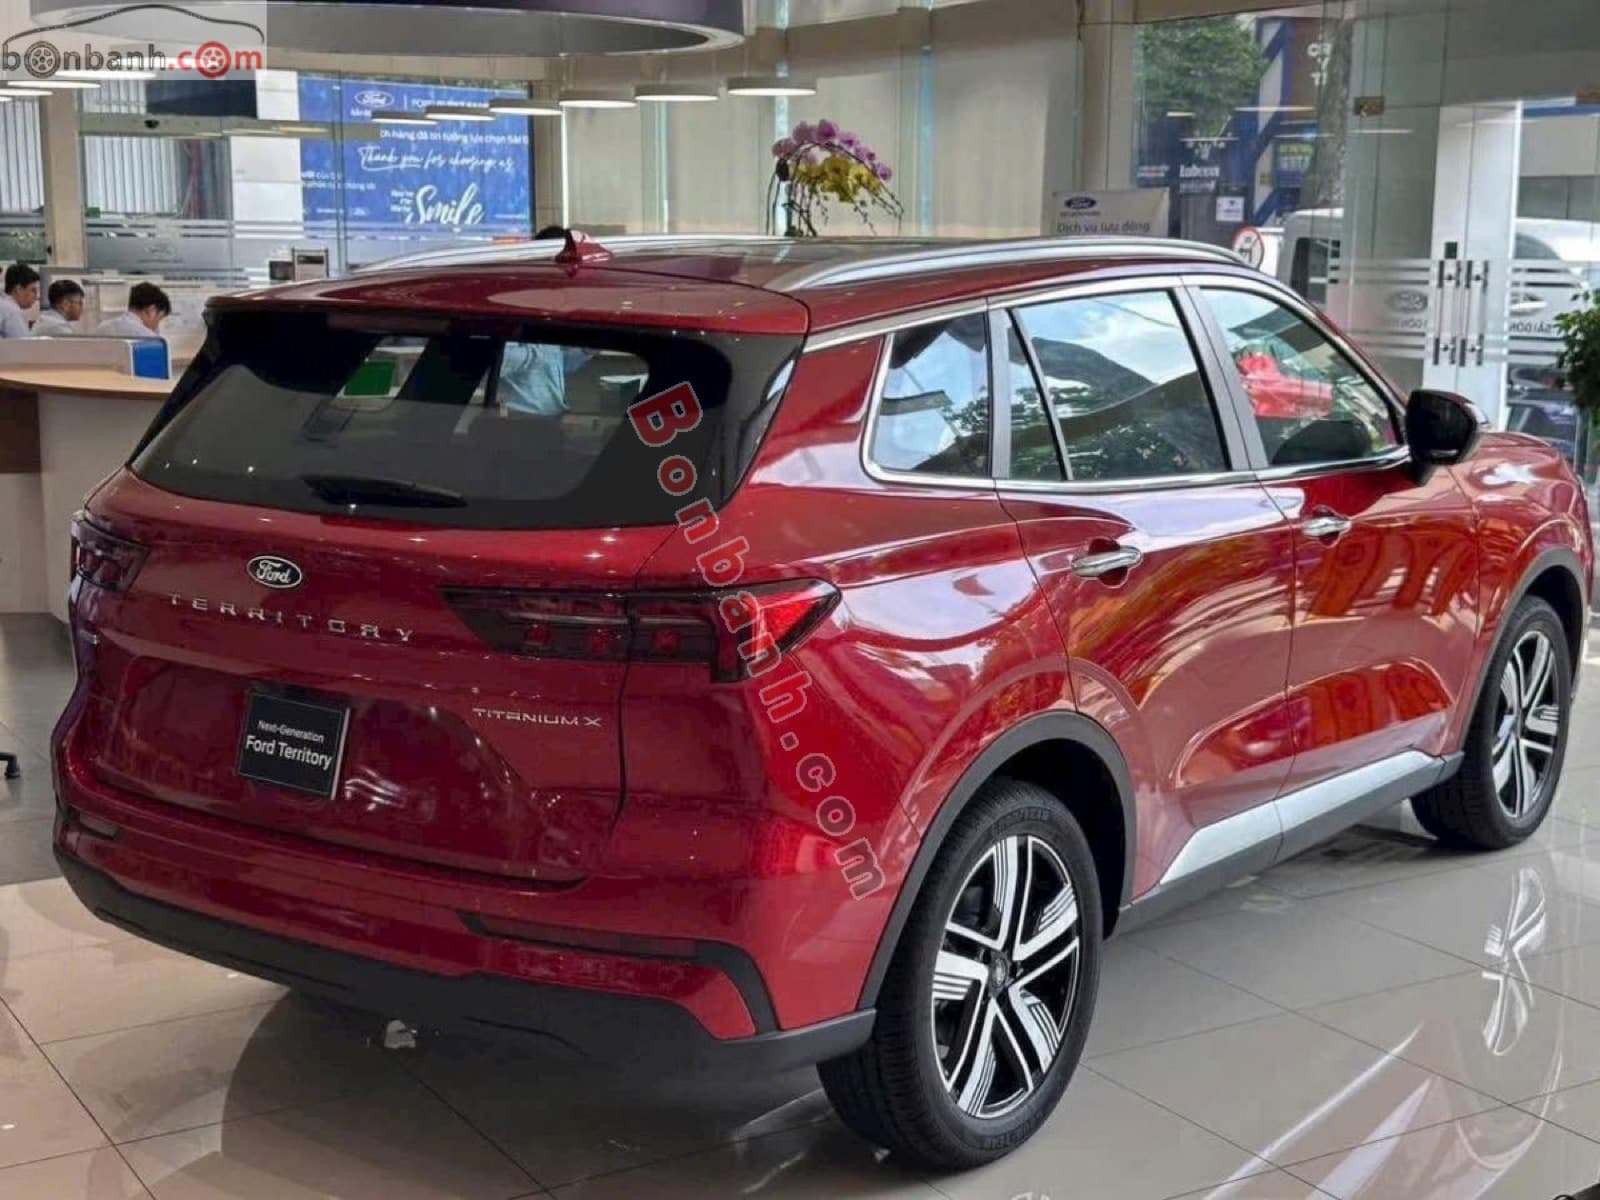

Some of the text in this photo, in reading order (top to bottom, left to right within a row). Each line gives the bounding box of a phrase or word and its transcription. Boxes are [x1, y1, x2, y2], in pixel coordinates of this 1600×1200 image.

[357, 146, 397, 170] Thank
[406, 182, 485, 224] Smile
[168, 593, 413, 642] TERRITORY
[257, 720, 325, 744] Next-Generation
[472, 707, 603, 727] TITANIUM X
[245, 735, 333, 771] Ford Territory
